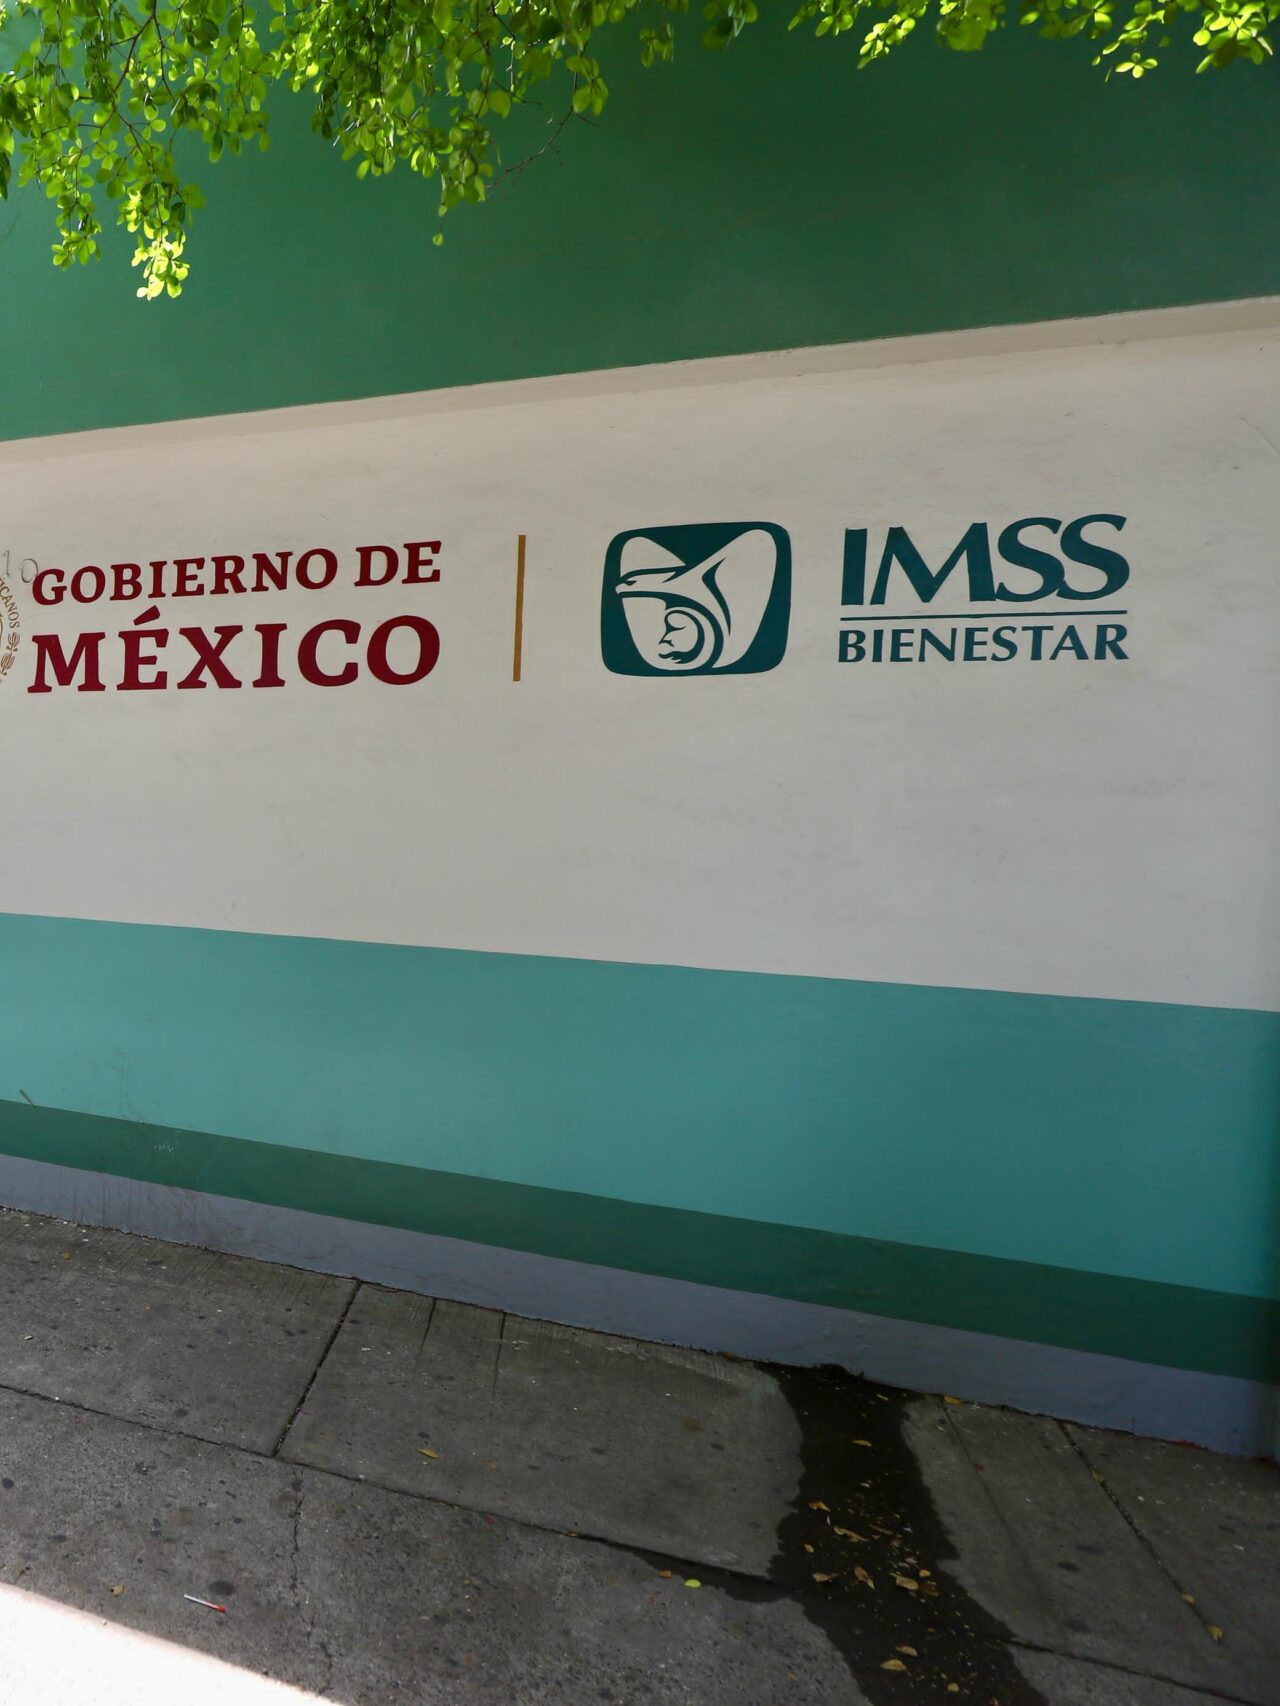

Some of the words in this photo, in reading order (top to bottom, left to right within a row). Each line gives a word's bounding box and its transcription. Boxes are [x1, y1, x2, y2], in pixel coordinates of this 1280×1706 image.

[32, 548, 338, 606] GOBIERNO
[354, 540, 442, 587] DE
[841, 513, 1130, 606] IMSS
[27, 605, 440, 693] MÉXICO
[838, 623, 1129, 663] BIENESTAR
